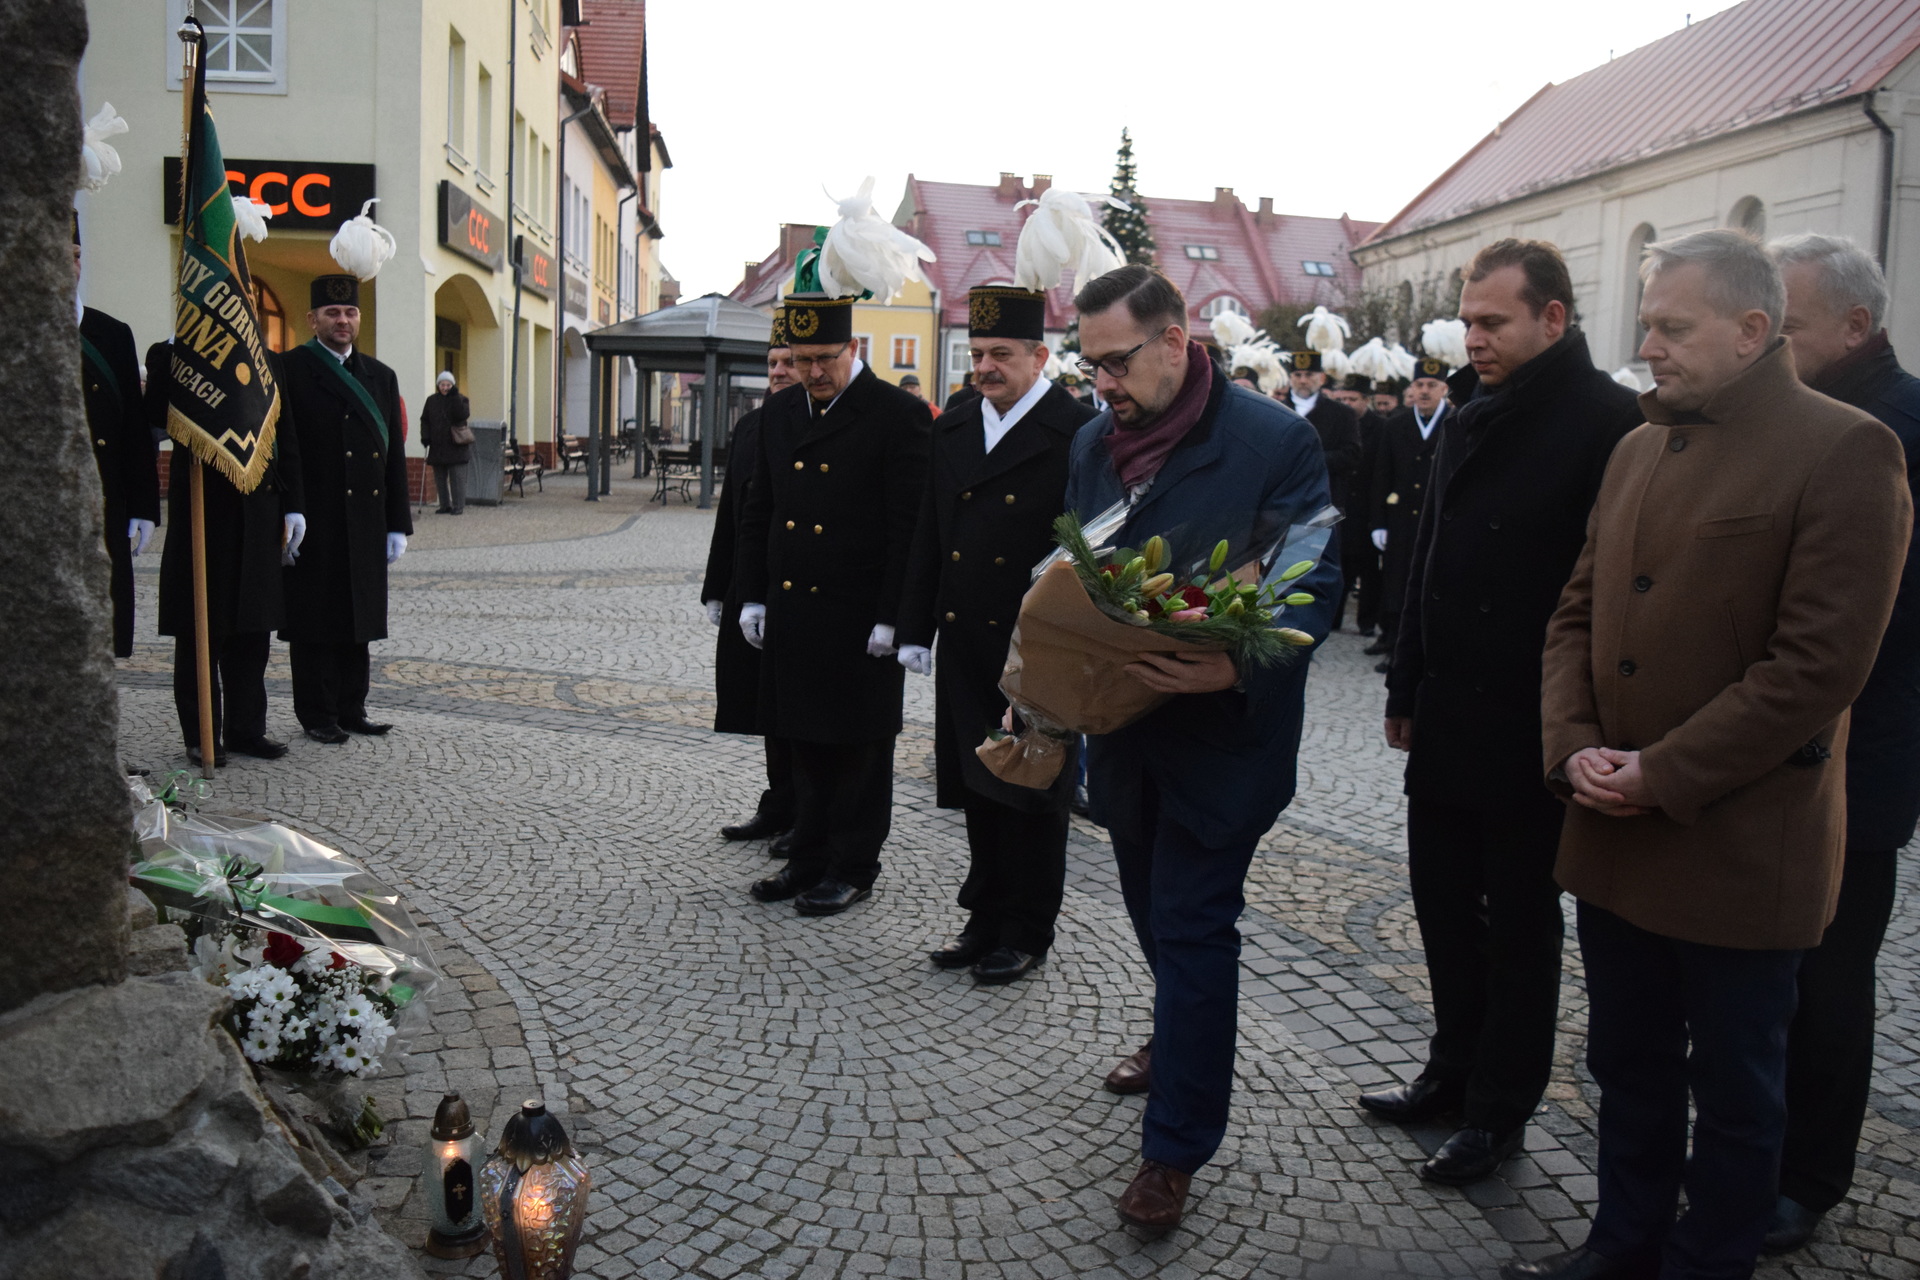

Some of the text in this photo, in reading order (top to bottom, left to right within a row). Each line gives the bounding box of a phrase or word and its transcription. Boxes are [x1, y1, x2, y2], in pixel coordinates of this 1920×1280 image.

[468, 208, 489, 254] CCC
[181, 250, 215, 294] DY
[533, 254, 548, 288] CCC
[175, 296, 238, 370] DNA
